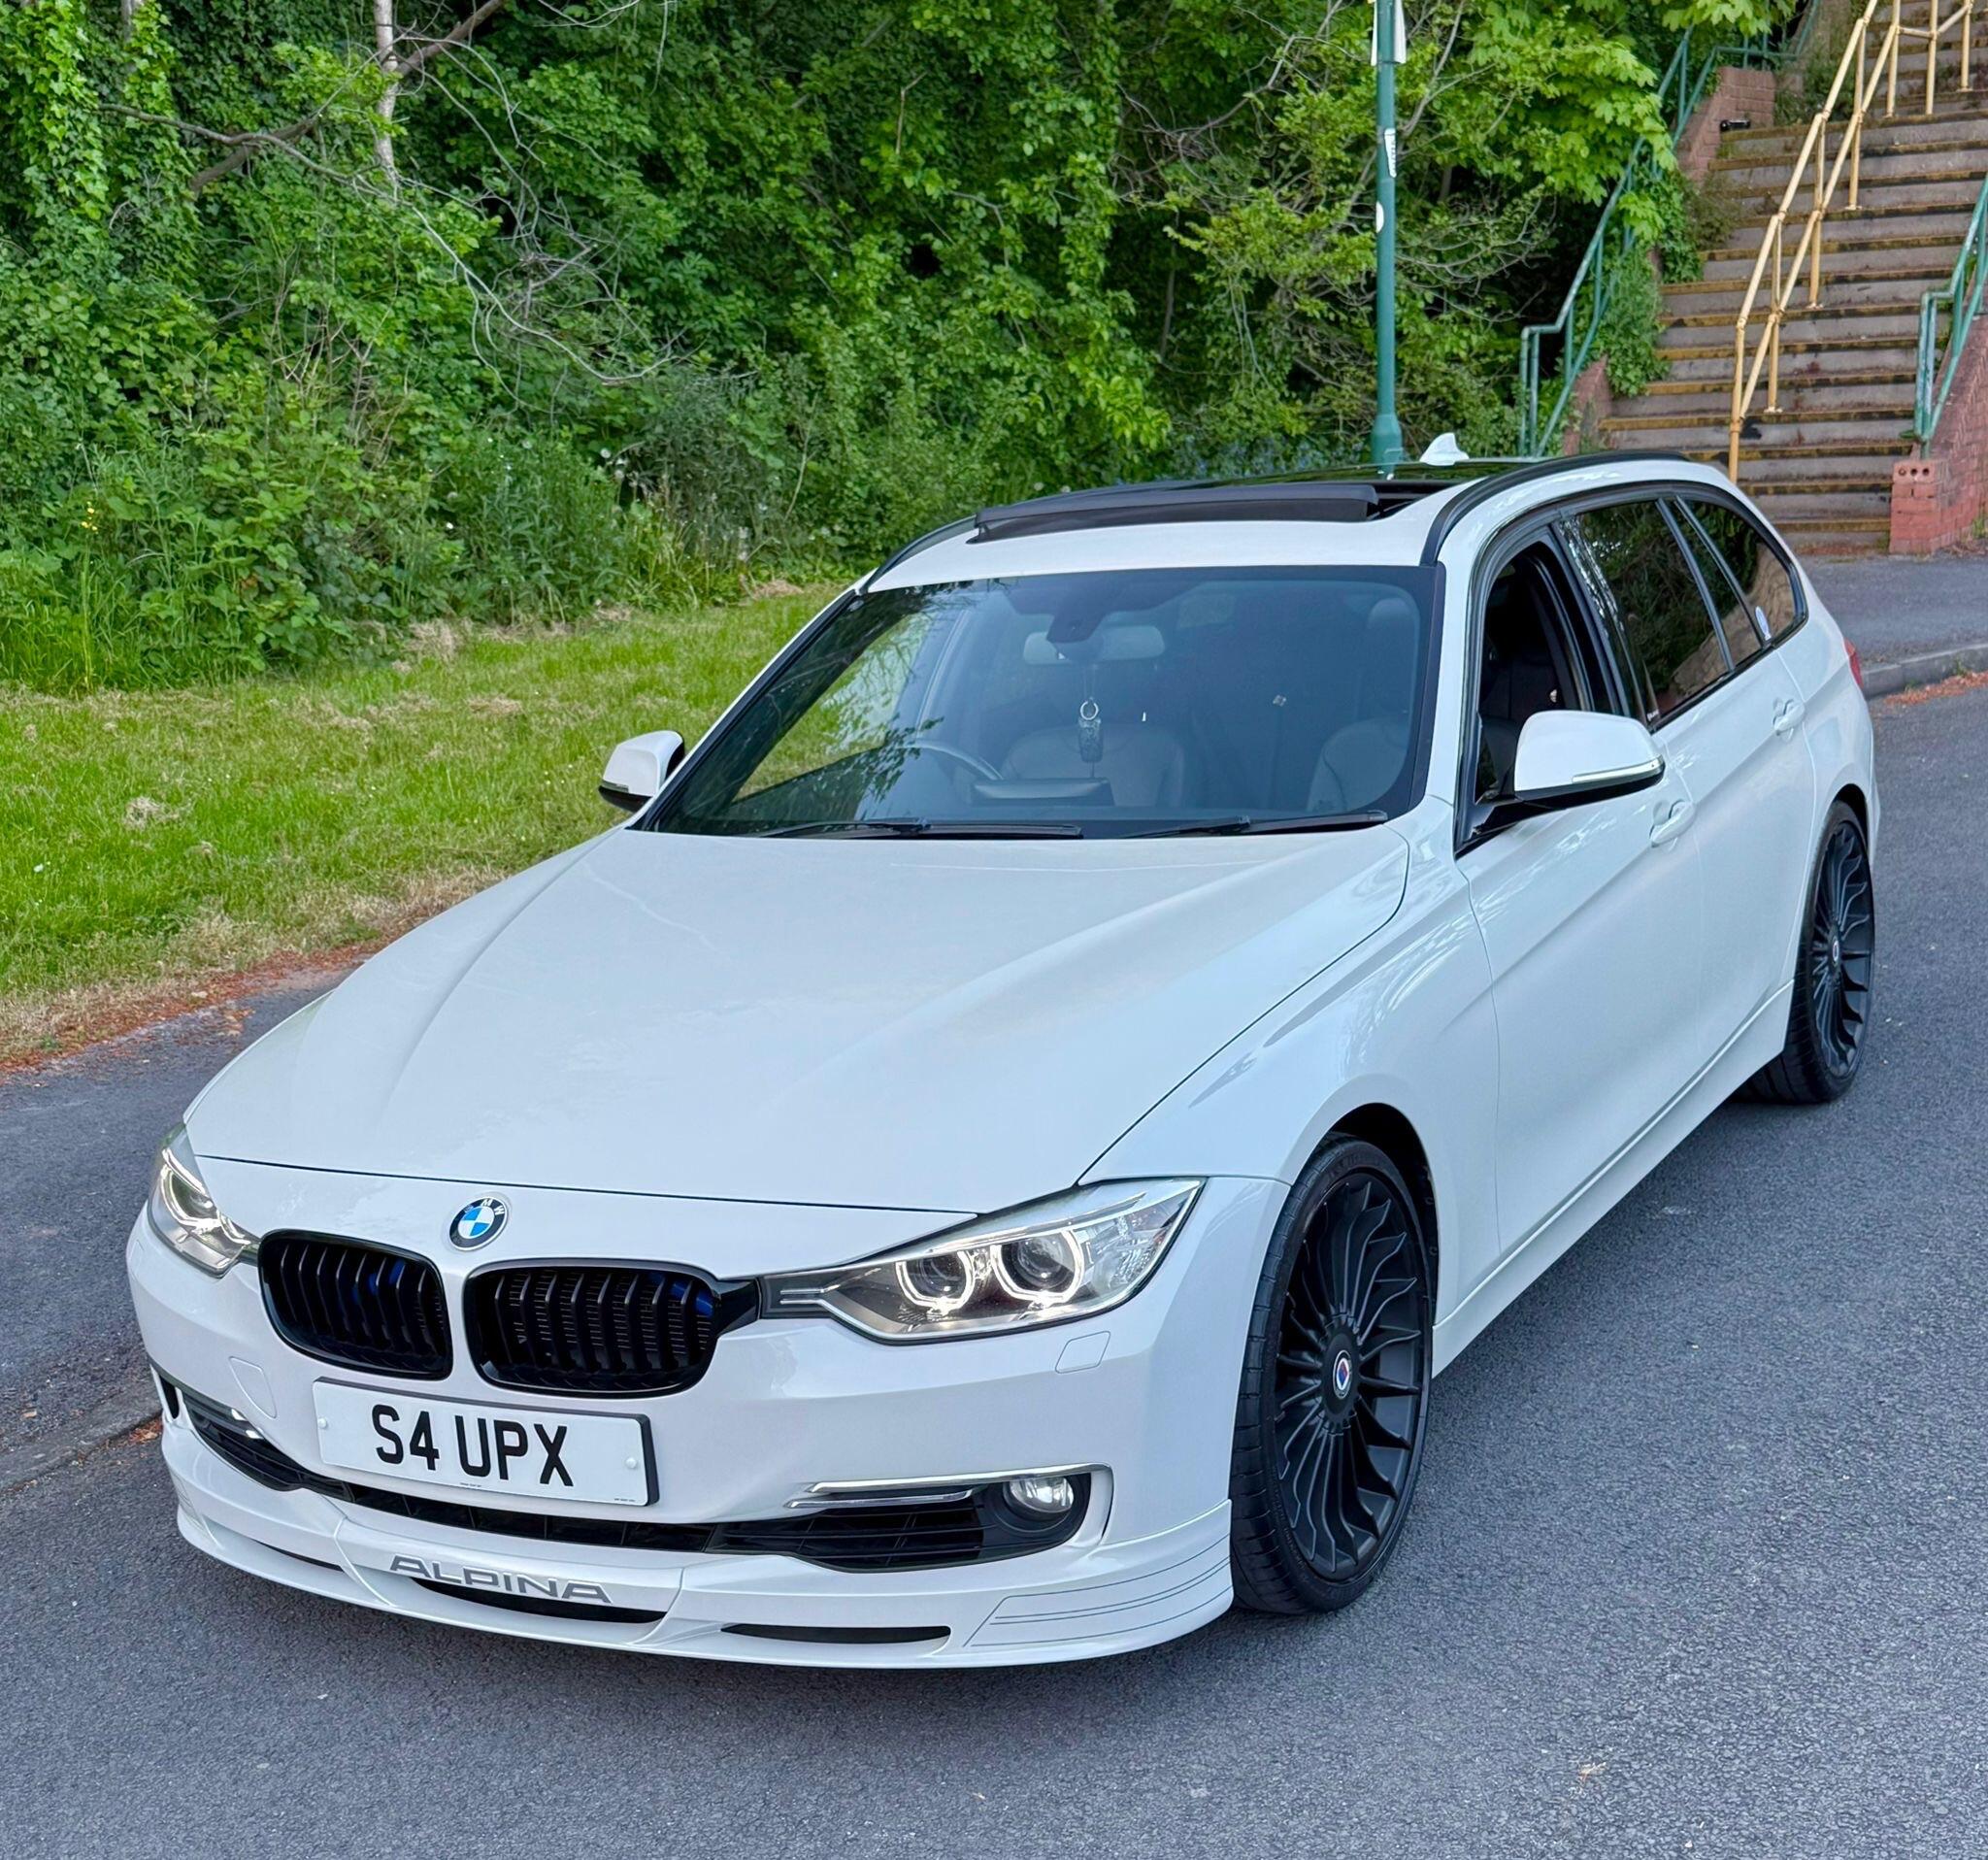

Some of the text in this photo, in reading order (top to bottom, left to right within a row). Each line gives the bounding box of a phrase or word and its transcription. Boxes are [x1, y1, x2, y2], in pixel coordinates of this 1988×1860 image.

[372, 1404, 574, 1487] S4 UPX
[389, 1554, 613, 1604] ALPINA
